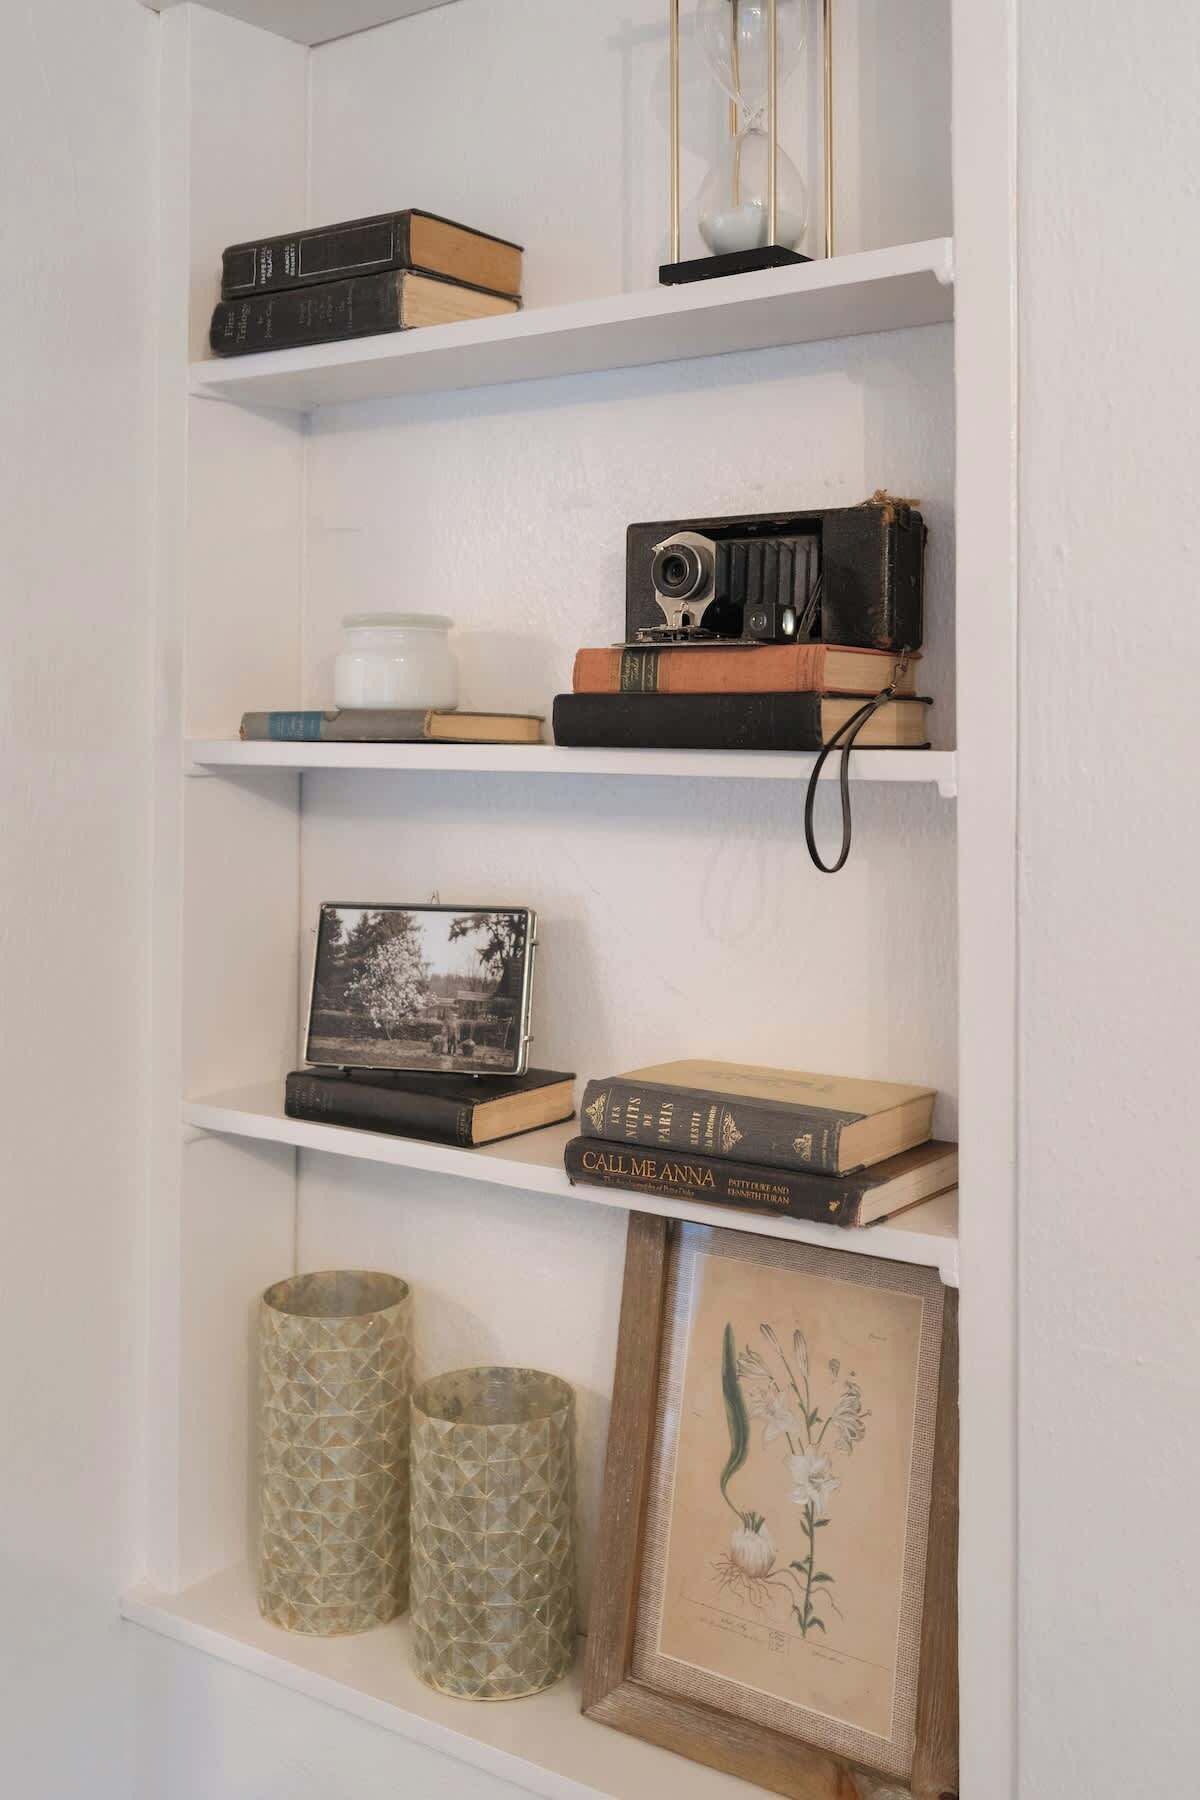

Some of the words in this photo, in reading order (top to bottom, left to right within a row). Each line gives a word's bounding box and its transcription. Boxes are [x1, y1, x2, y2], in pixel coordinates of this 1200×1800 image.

[610, 1104, 621, 1125] LES
[624, 1096, 641, 1140] NUITS
[642, 1111, 653, 1128] DE
[658, 1102, 674, 1143] PARIS
[583, 1151, 627, 1174] CALL
[630, 1157, 657, 1179] ME
[659, 1162, 716, 1188] ANNA
[727, 1187, 760, 1200] KENNETH
[763, 1191, 790, 1205] TURAN
[728, 1178, 750, 1189] PATTY
[751, 1182, 771, 1192] DUKE
[771, 1185, 790, 1196] AND
